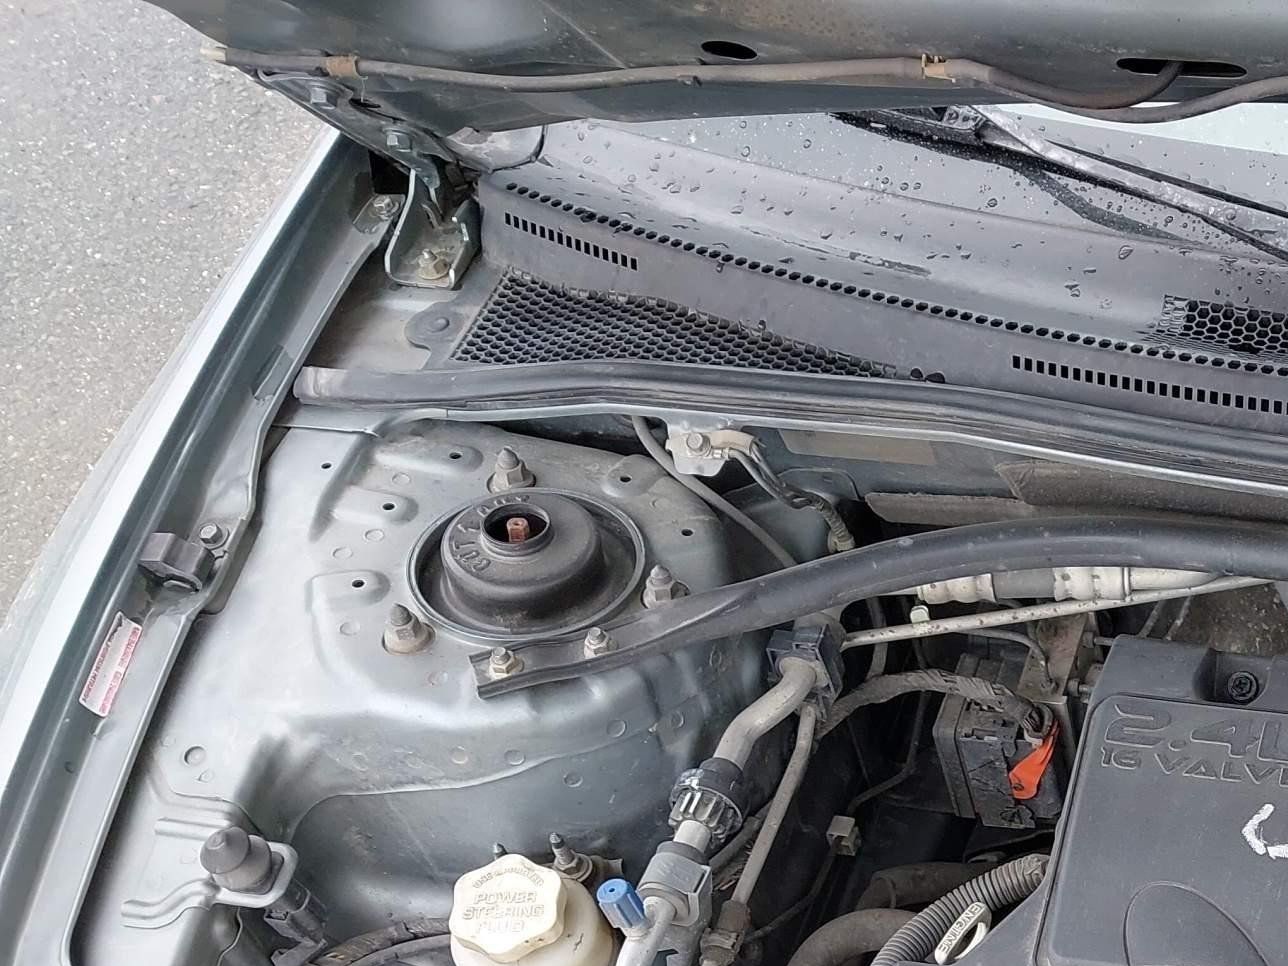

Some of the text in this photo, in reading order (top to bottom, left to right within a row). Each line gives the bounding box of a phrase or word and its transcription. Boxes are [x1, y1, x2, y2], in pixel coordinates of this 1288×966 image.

[1100, 746, 1142, 770] 16
[473, 890, 538, 904] POWER
[462, 904, 545, 920] STEERING
[938, 903, 983, 954] ENGINE
